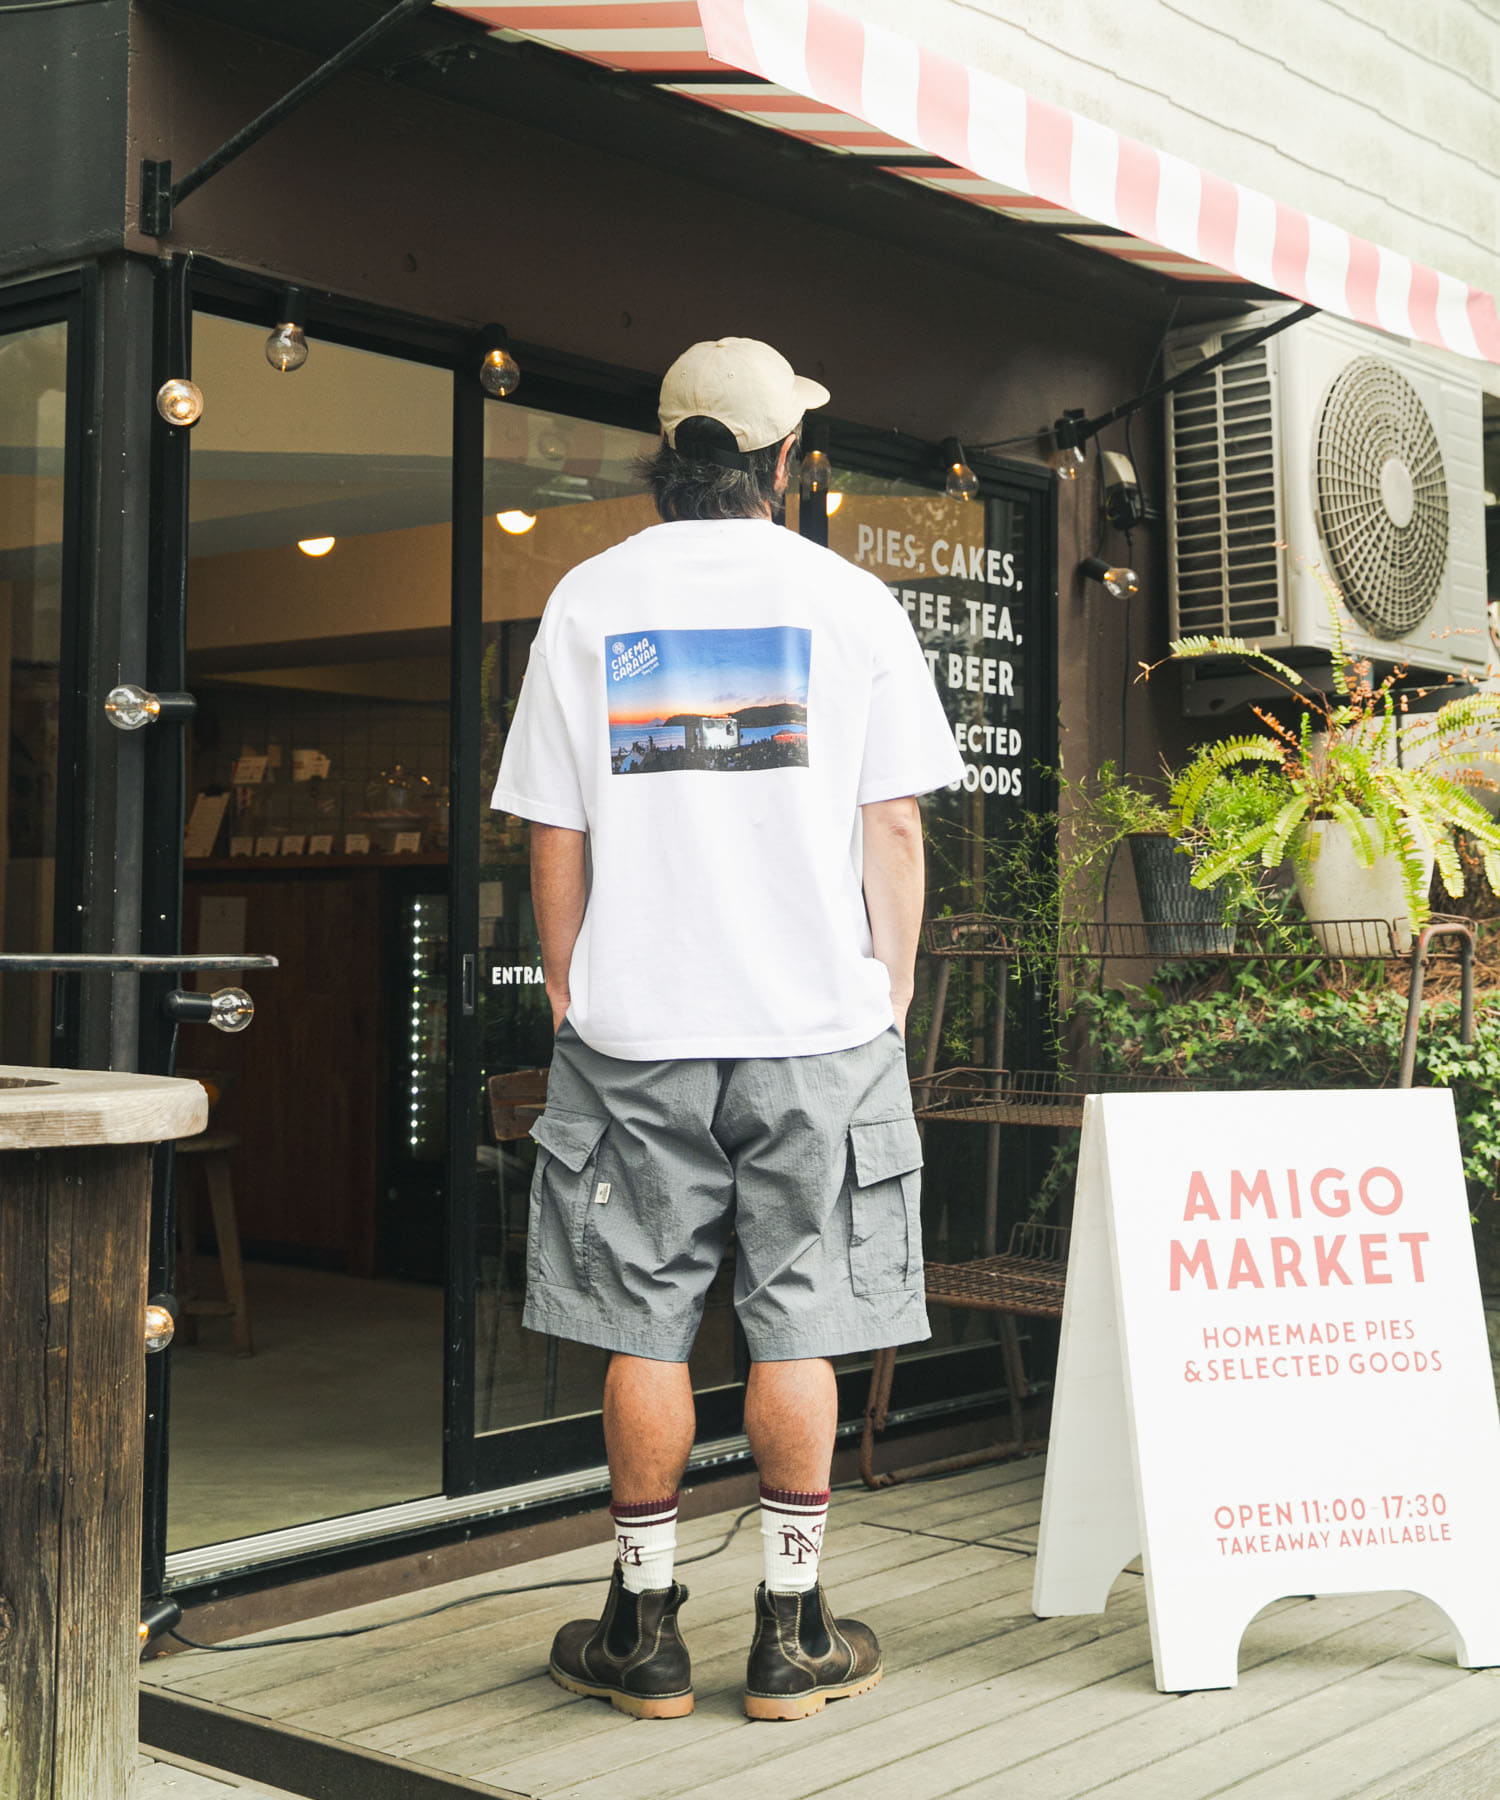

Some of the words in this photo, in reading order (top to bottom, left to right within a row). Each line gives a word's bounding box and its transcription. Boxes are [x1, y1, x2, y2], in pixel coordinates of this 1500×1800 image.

[858, 524, 926, 574] PIES,
[931, 540, 1024, 592] CAKES,
[888, 587, 960, 636] FEE,
[965, 600, 1024, 647] TEA,
[611, 638, 650, 670] CINEMA
[612, 643, 657, 681] CARAVAN
[948, 653, 1015, 697] BEER
[955, 723, 1022, 756] ECTED
[492, 966, 546, 985] ENTRA
[1183, 1166, 1404, 1222] AMIGO
[1169, 1231, 1430, 1291] MARKET
[1202, 1322, 1357, 1349] HOMEMADE
[1365, 1319, 1415, 1341] PIES
[1348, 1350, 1443, 1375] GOODS
[1214, 1502, 1293, 1530] OPEN
[1216, 1530, 1331, 1556] TAKEAWAY
[1339, 1523, 1453, 1548] AVAILABLE
